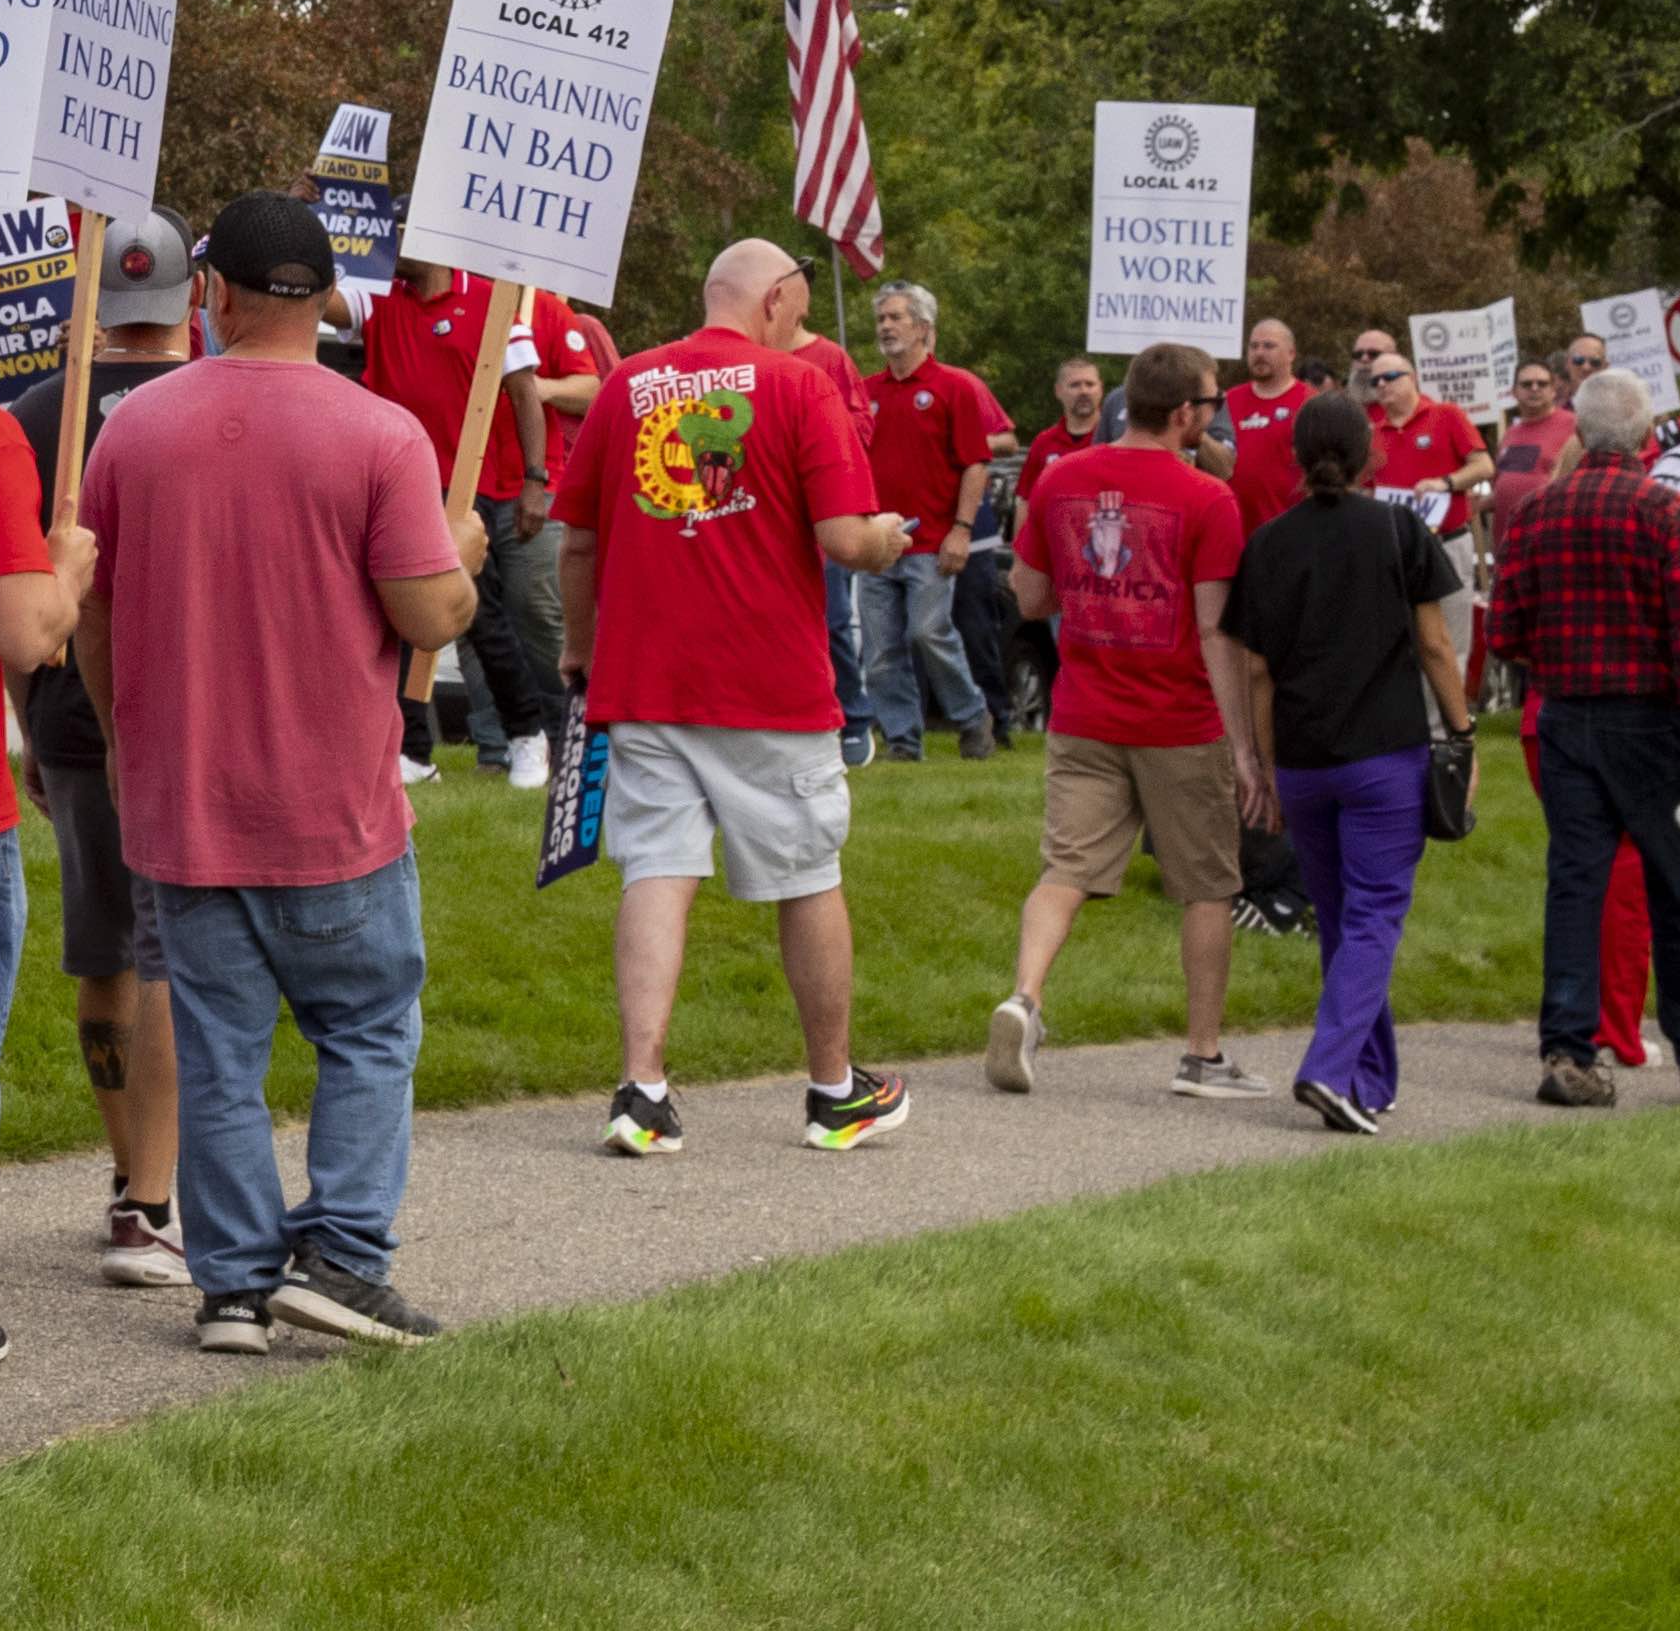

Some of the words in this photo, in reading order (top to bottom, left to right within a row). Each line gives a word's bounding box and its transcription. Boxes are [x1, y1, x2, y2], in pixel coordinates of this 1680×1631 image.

[498, 3, 579, 38] LOCAL
[587, 24, 630, 50] 412
[58, 32, 93, 80] IN
[97, 45, 156, 101] BAD
[448, 54, 642, 132] BARGAINING
[59, 95, 142, 162] FAITH
[331, 111, 378, 154] UAW
[1158, 137, 1184, 150] UAW
[460, 112, 516, 158] IN
[526, 129, 613, 182] BAD
[361, 167, 383, 180] UP
[1123, 175, 1179, 189] LOCAL
[1185, 178, 1218, 192] 412
[324, 187, 376, 210] COLA
[462, 172, 593, 239] FAITH
[318, 213, 351, 235] AIR
[354, 216, 393, 237] PAY
[1104, 216, 1235, 248] HOSTILE
[331, 236, 374, 257] OW
[37, 259, 68, 279] UP
[1119, 255, 1216, 285] WORK
[1095, 292, 1238, 325] ENVIRONMENT
[628, 365, 680, 388] WILL
[629, 364, 756, 419] STRIKE
[664, 442, 695, 468] UA
[218, 1305, 256, 1320] adidas
